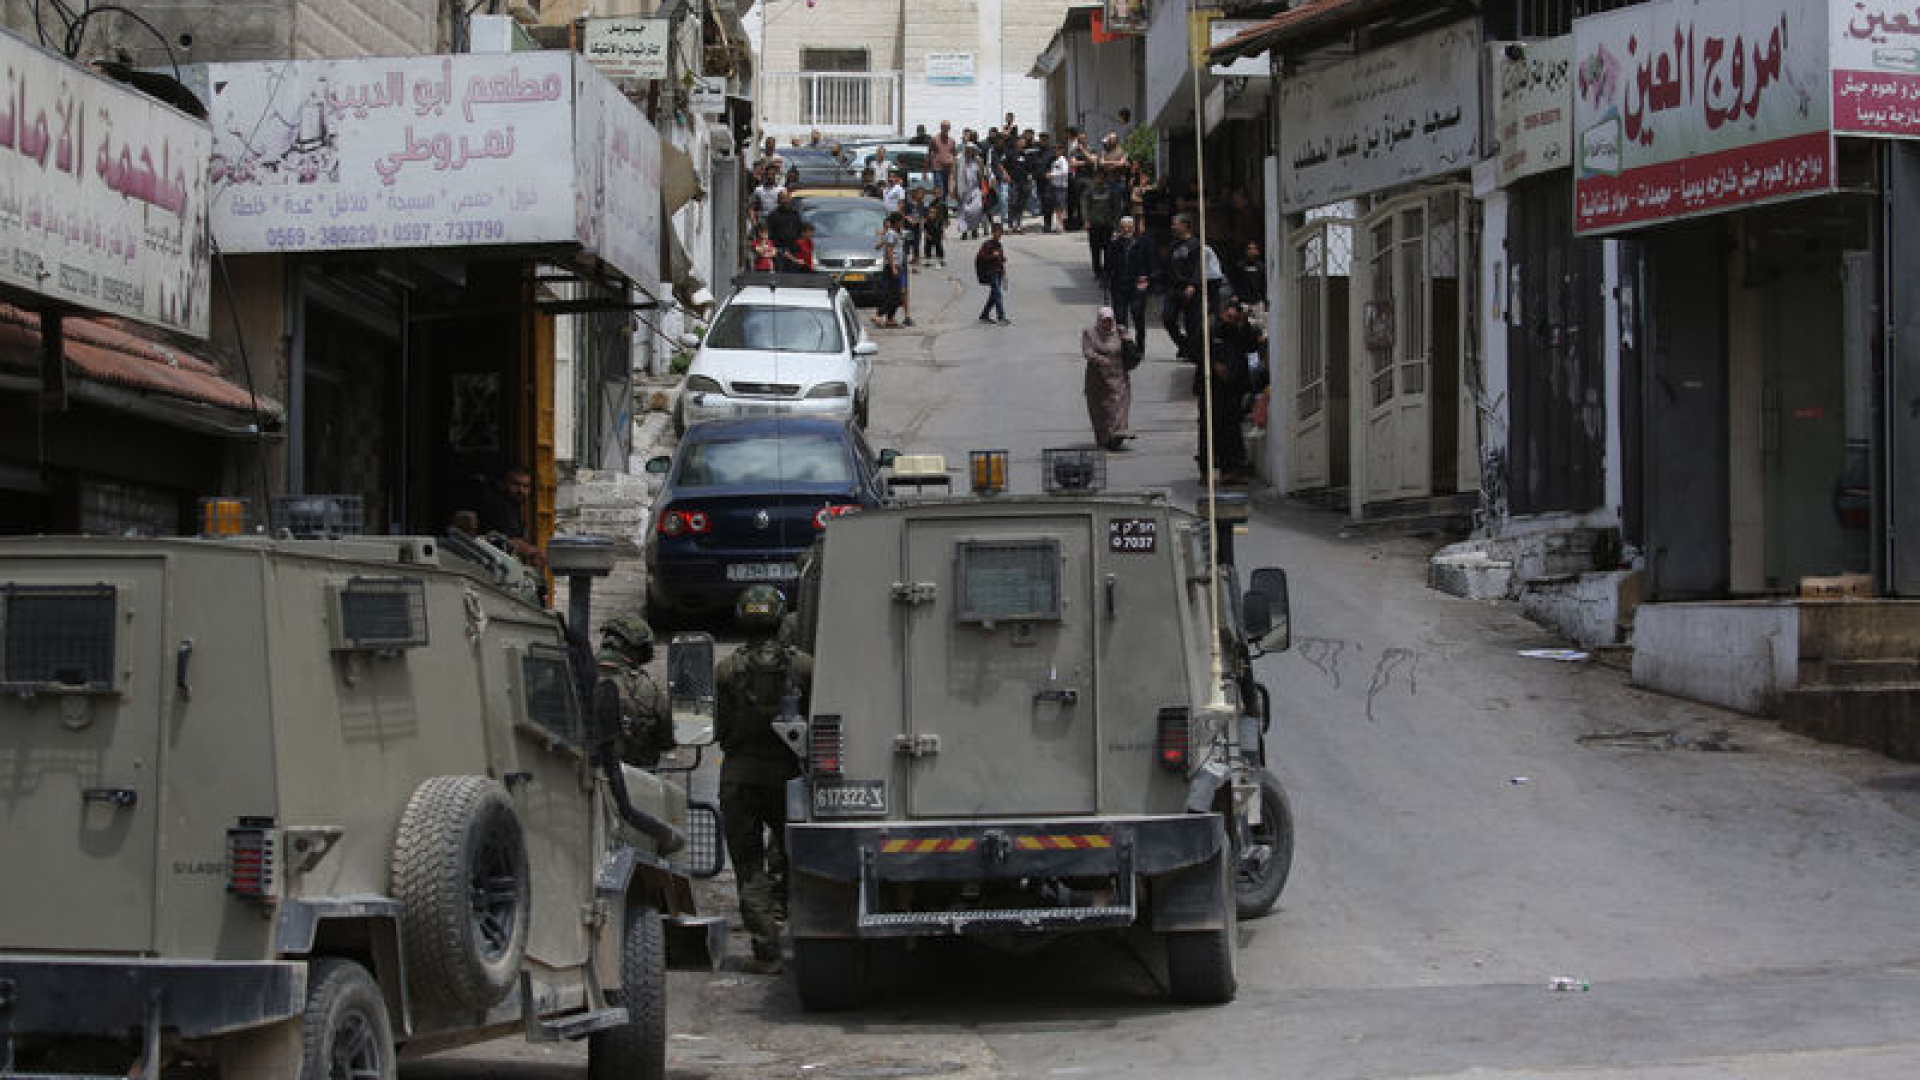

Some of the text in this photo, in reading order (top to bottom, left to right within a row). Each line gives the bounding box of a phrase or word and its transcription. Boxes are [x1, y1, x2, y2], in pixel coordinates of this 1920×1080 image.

[461, 67, 562, 122] مطعم
[1423, 106, 1461, 143] مسجد
[1625, 20, 1694, 146] العين
[96, 107, 188, 219] ملحمة
